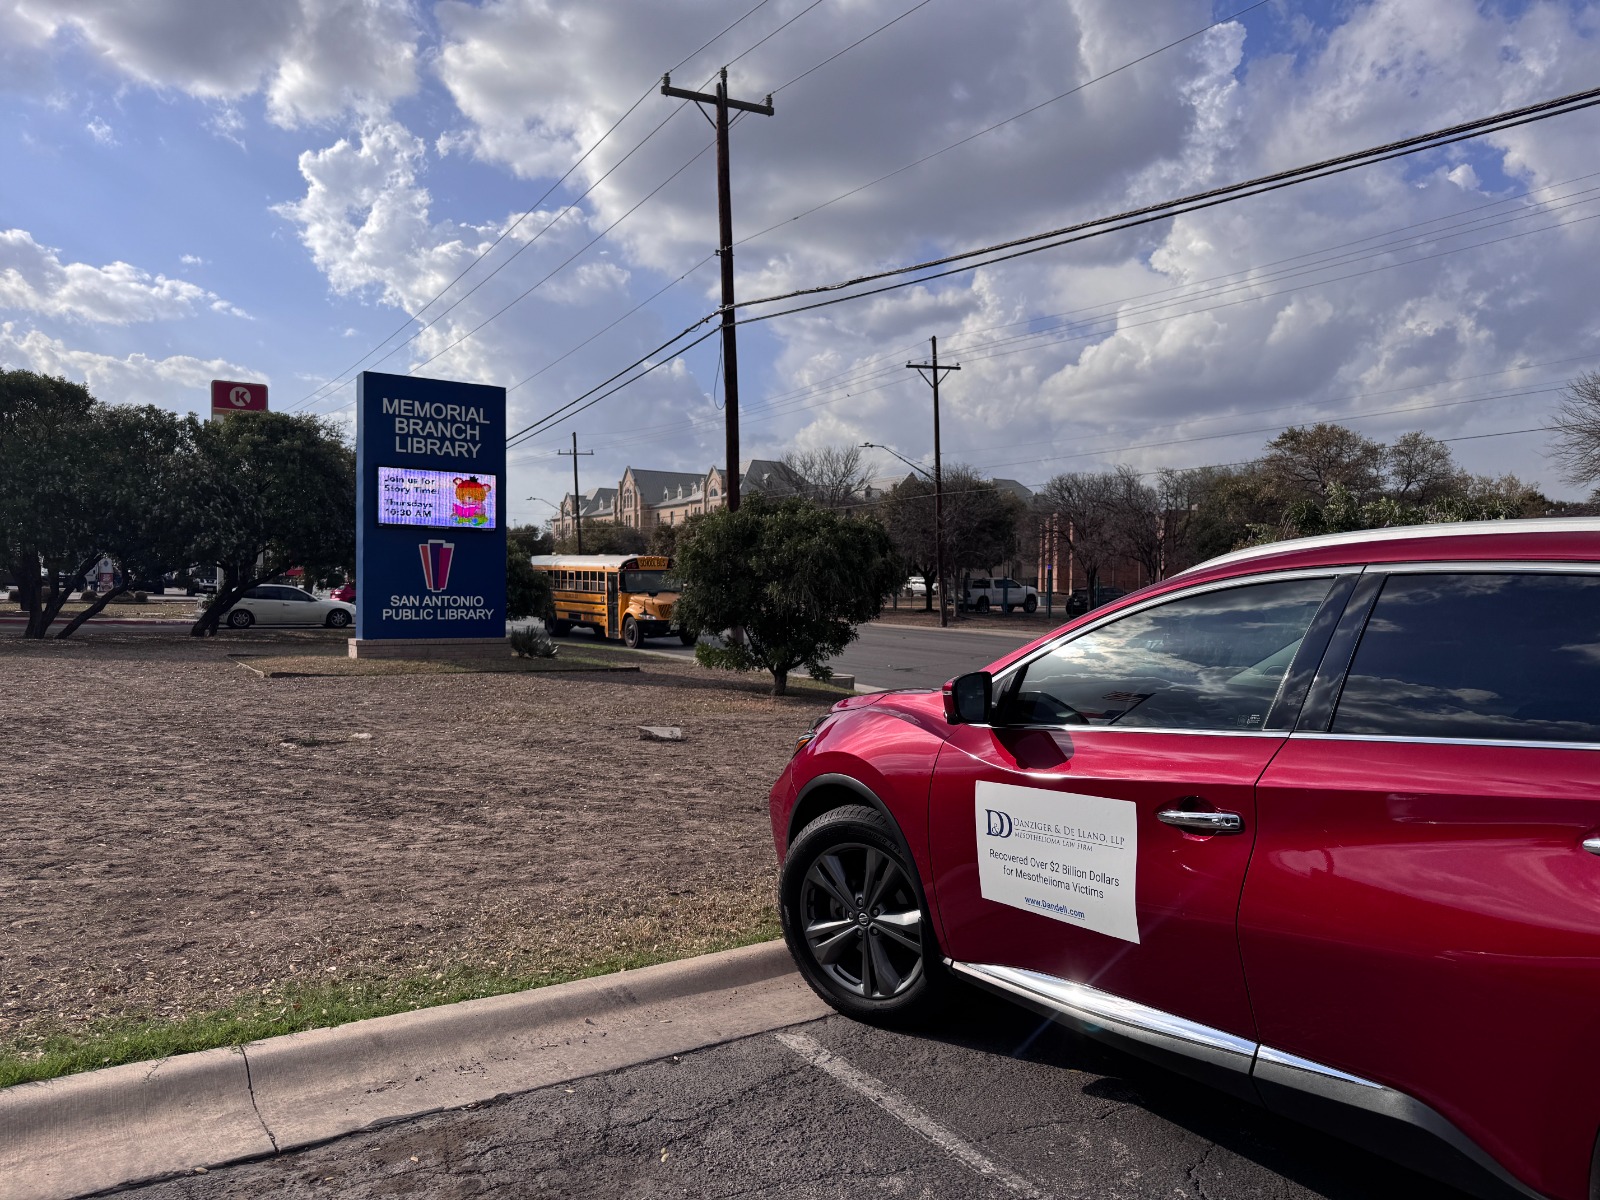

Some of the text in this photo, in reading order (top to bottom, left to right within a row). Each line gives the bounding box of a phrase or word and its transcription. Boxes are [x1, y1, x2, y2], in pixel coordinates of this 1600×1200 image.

[382, 397, 490, 424] MEMORIAL
[395, 417, 480, 441] BRANCH
[395, 436, 482, 458] LIBRARY
[384, 475, 405, 483] Join
[421, 477, 435, 485] for
[384, 484, 410, 495] Story
[384, 498, 433, 509] Thursdays
[385, 508, 412, 517] 10:30
[640, 559, 666, 567] SCHOOL BUS
[390, 595, 484, 607] SAN ANTONIO
[382, 609, 494, 620] PUBLIC LIBRARY
[1014, 832, 1093, 852] MESOTHELIOMA LAW FIRM
[1054, 824, 1061, 834] &
[1110, 835, 1125, 846] LLP
[989, 848, 1120, 887] Recovered Over $2 Billion Dollars
[1003, 864, 1104, 899] for Mesothelioma Victims
